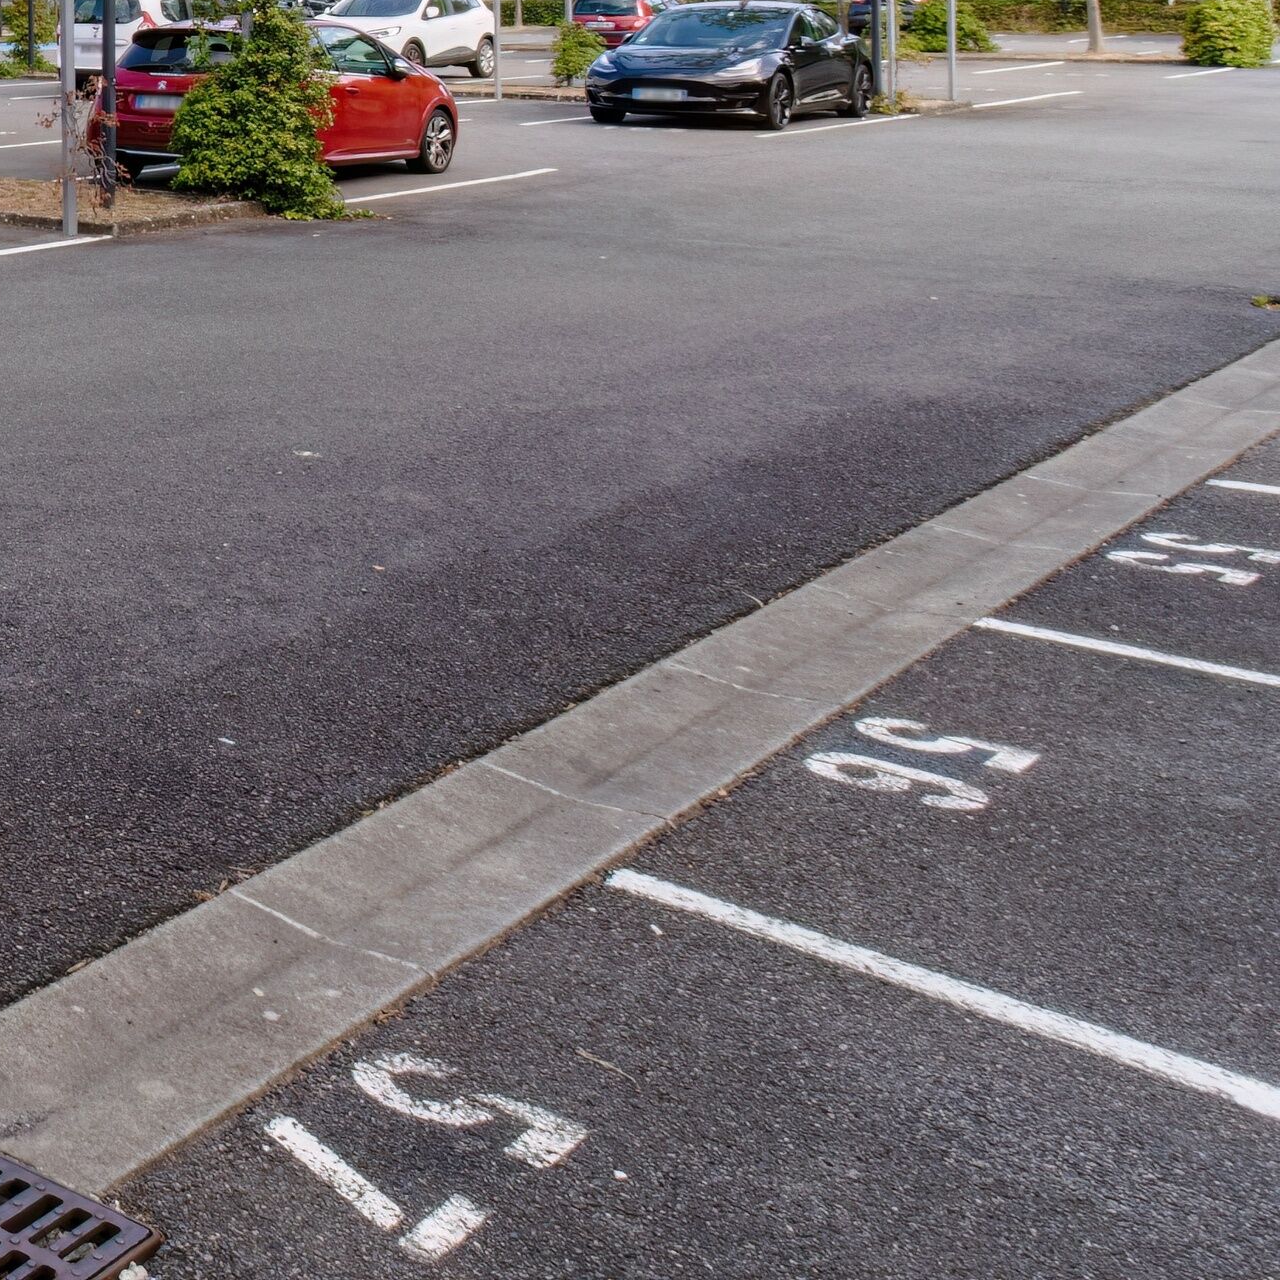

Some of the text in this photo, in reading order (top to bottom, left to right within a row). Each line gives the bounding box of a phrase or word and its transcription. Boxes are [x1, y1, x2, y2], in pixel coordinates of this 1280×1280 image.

[1105, 532, 1280, 586] 55
[804, 716, 1041, 811] 56
[262, 1050, 590, 1265] 57
